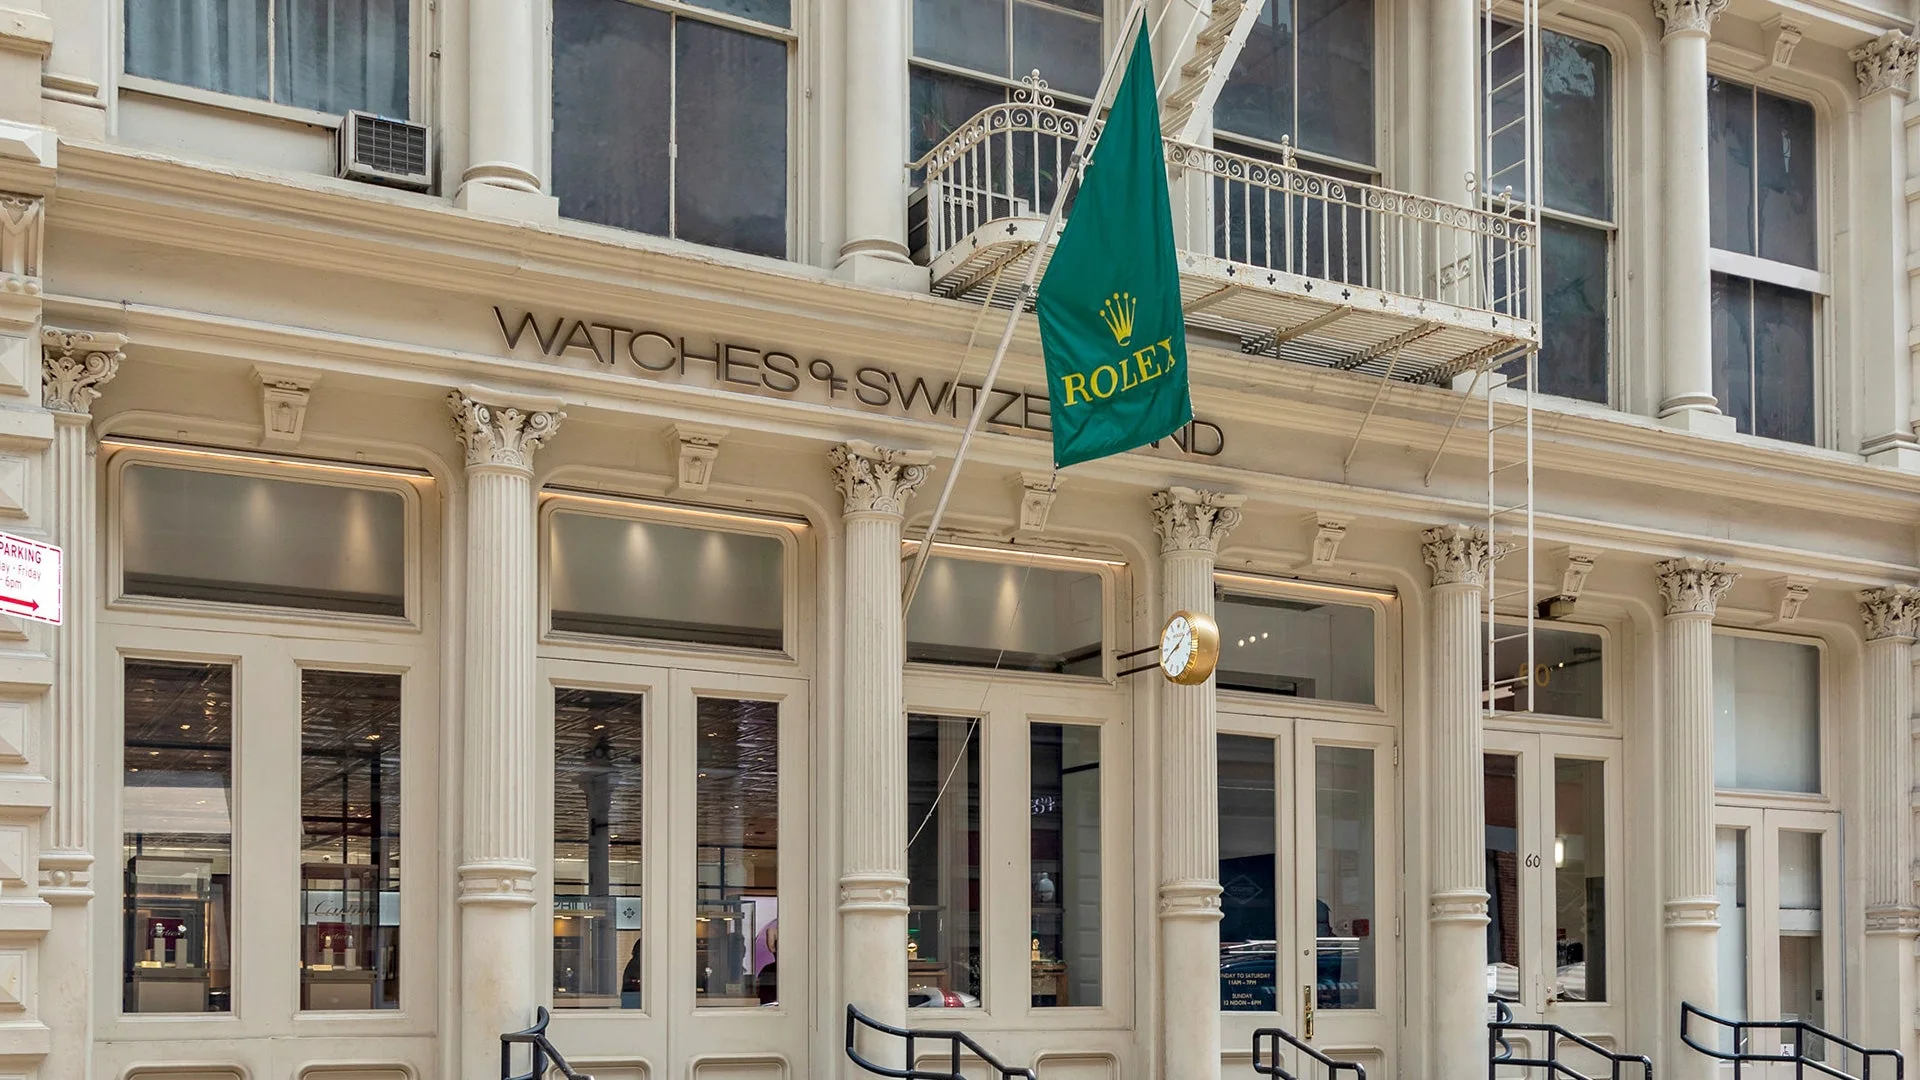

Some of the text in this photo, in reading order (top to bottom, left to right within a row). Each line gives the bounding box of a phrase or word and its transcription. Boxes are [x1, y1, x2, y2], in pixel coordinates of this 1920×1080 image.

[492, 305, 801, 393] WATCHES
[1060, 335, 1177, 407] ROLEX
[18, 564, 42, 582] Friday
[5, 575, 22, 590] 6pm
[1525, 853, 1541, 868] 60
